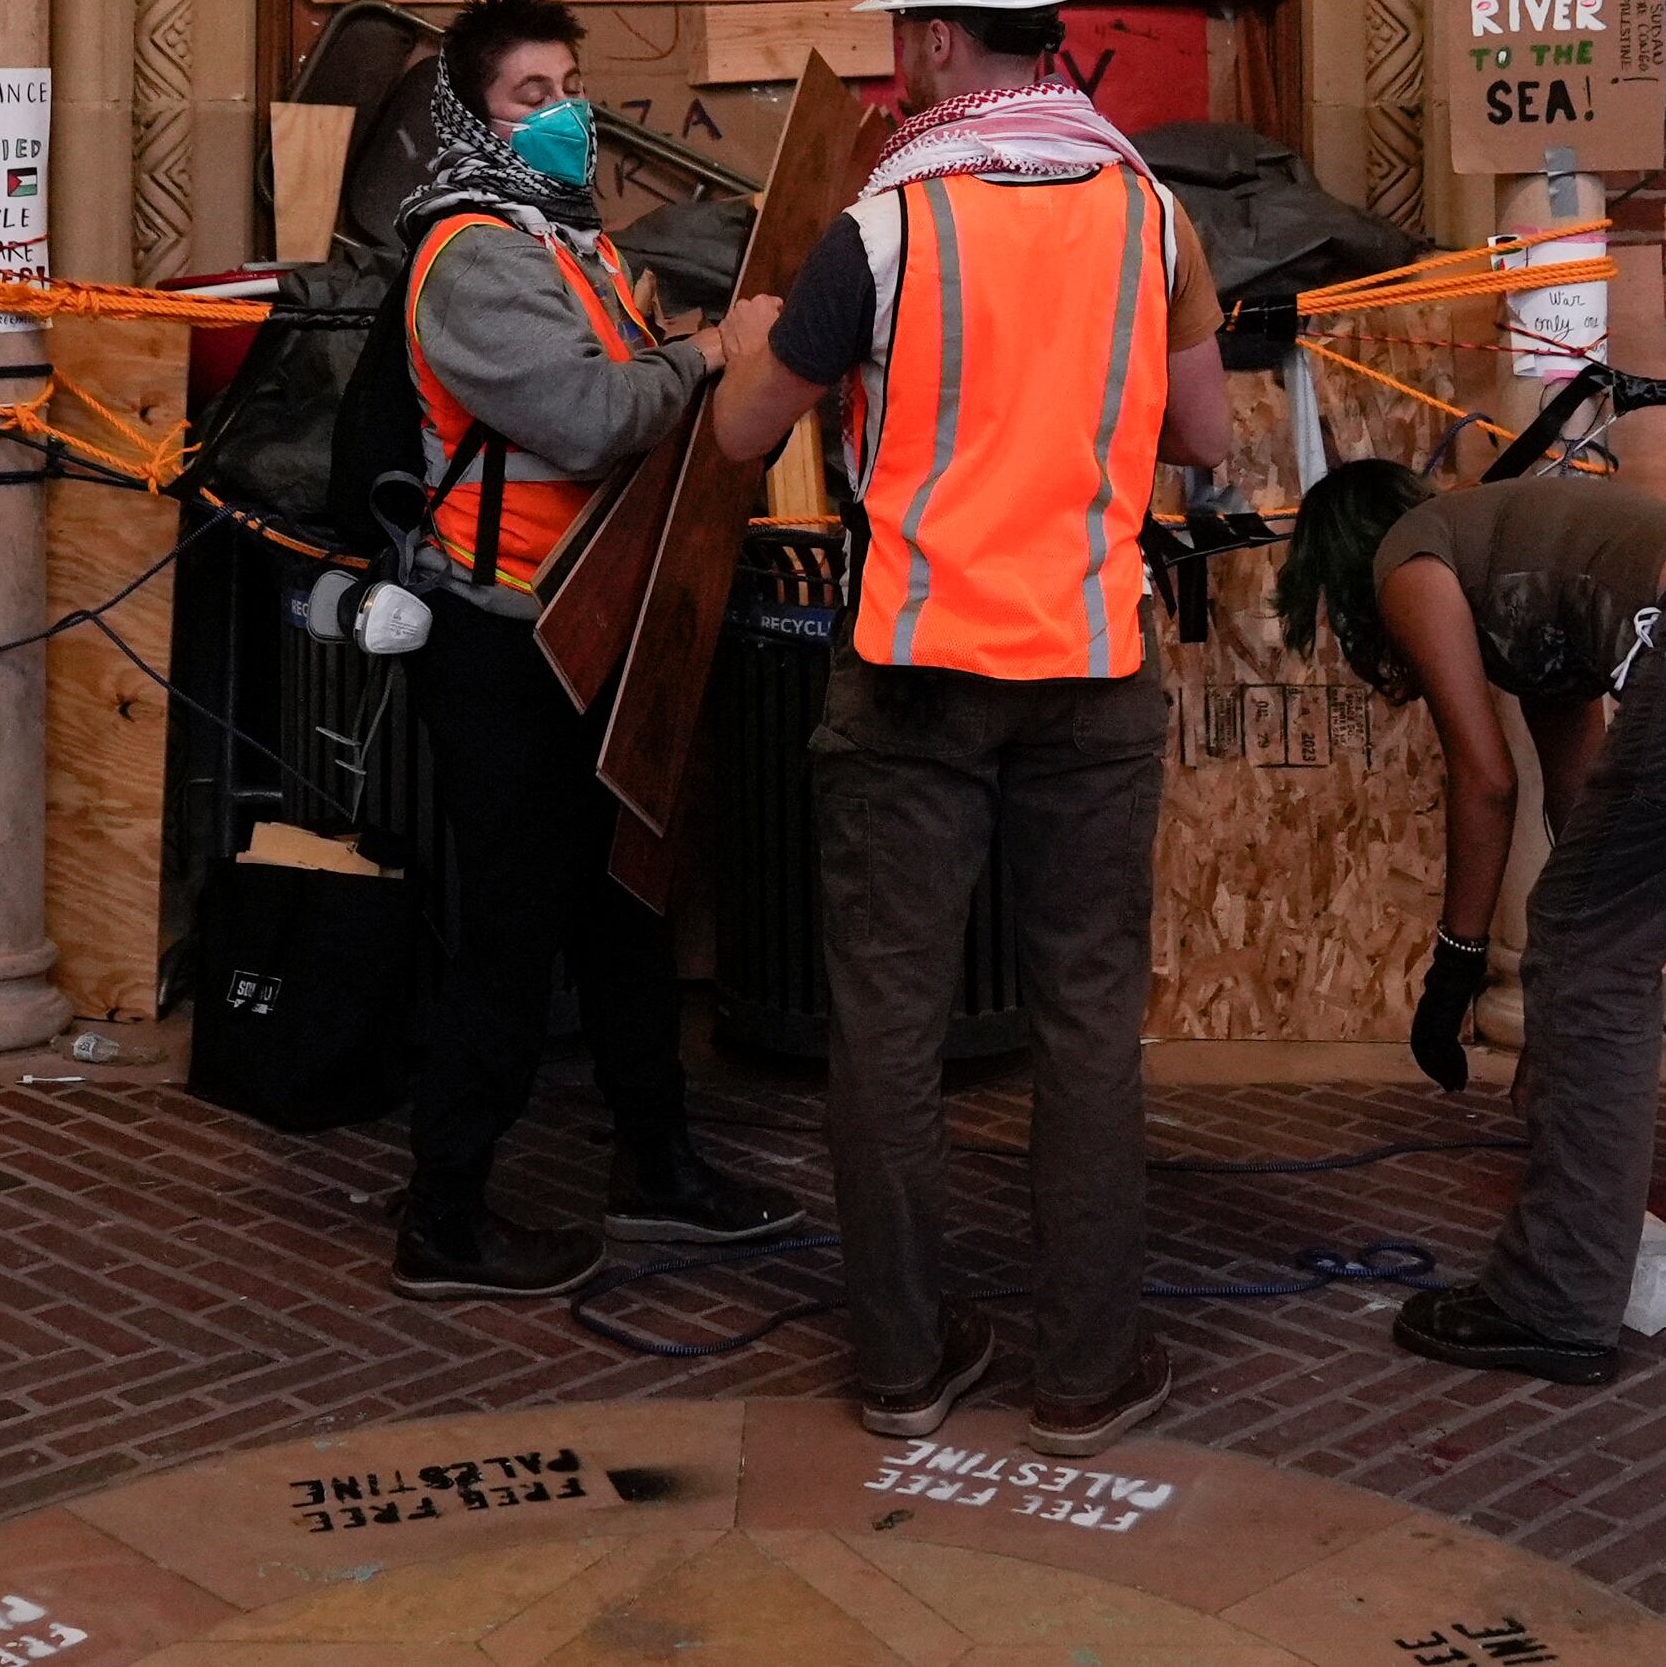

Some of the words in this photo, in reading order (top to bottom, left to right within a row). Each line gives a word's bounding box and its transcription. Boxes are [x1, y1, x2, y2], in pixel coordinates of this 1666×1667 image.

[1468, 47, 1512, 72] TO
[1530, 40, 1594, 66] THE
[1486, 76, 1595, 126] SEA!
[1549, 291, 1586, 306] War
[1535, 314, 1575, 344] only
[760, 615, 832, 638] RECYCL
[288, 1447, 580, 1508] PALESTINE
[459, 1476, 589, 1512] FREE
[864, 1466, 1000, 1508] FREE
[882, 1438, 1175, 1511] PALESTINE
[301, 1494, 439, 1534] FREE
[1012, 1492, 1143, 1534] FREE
